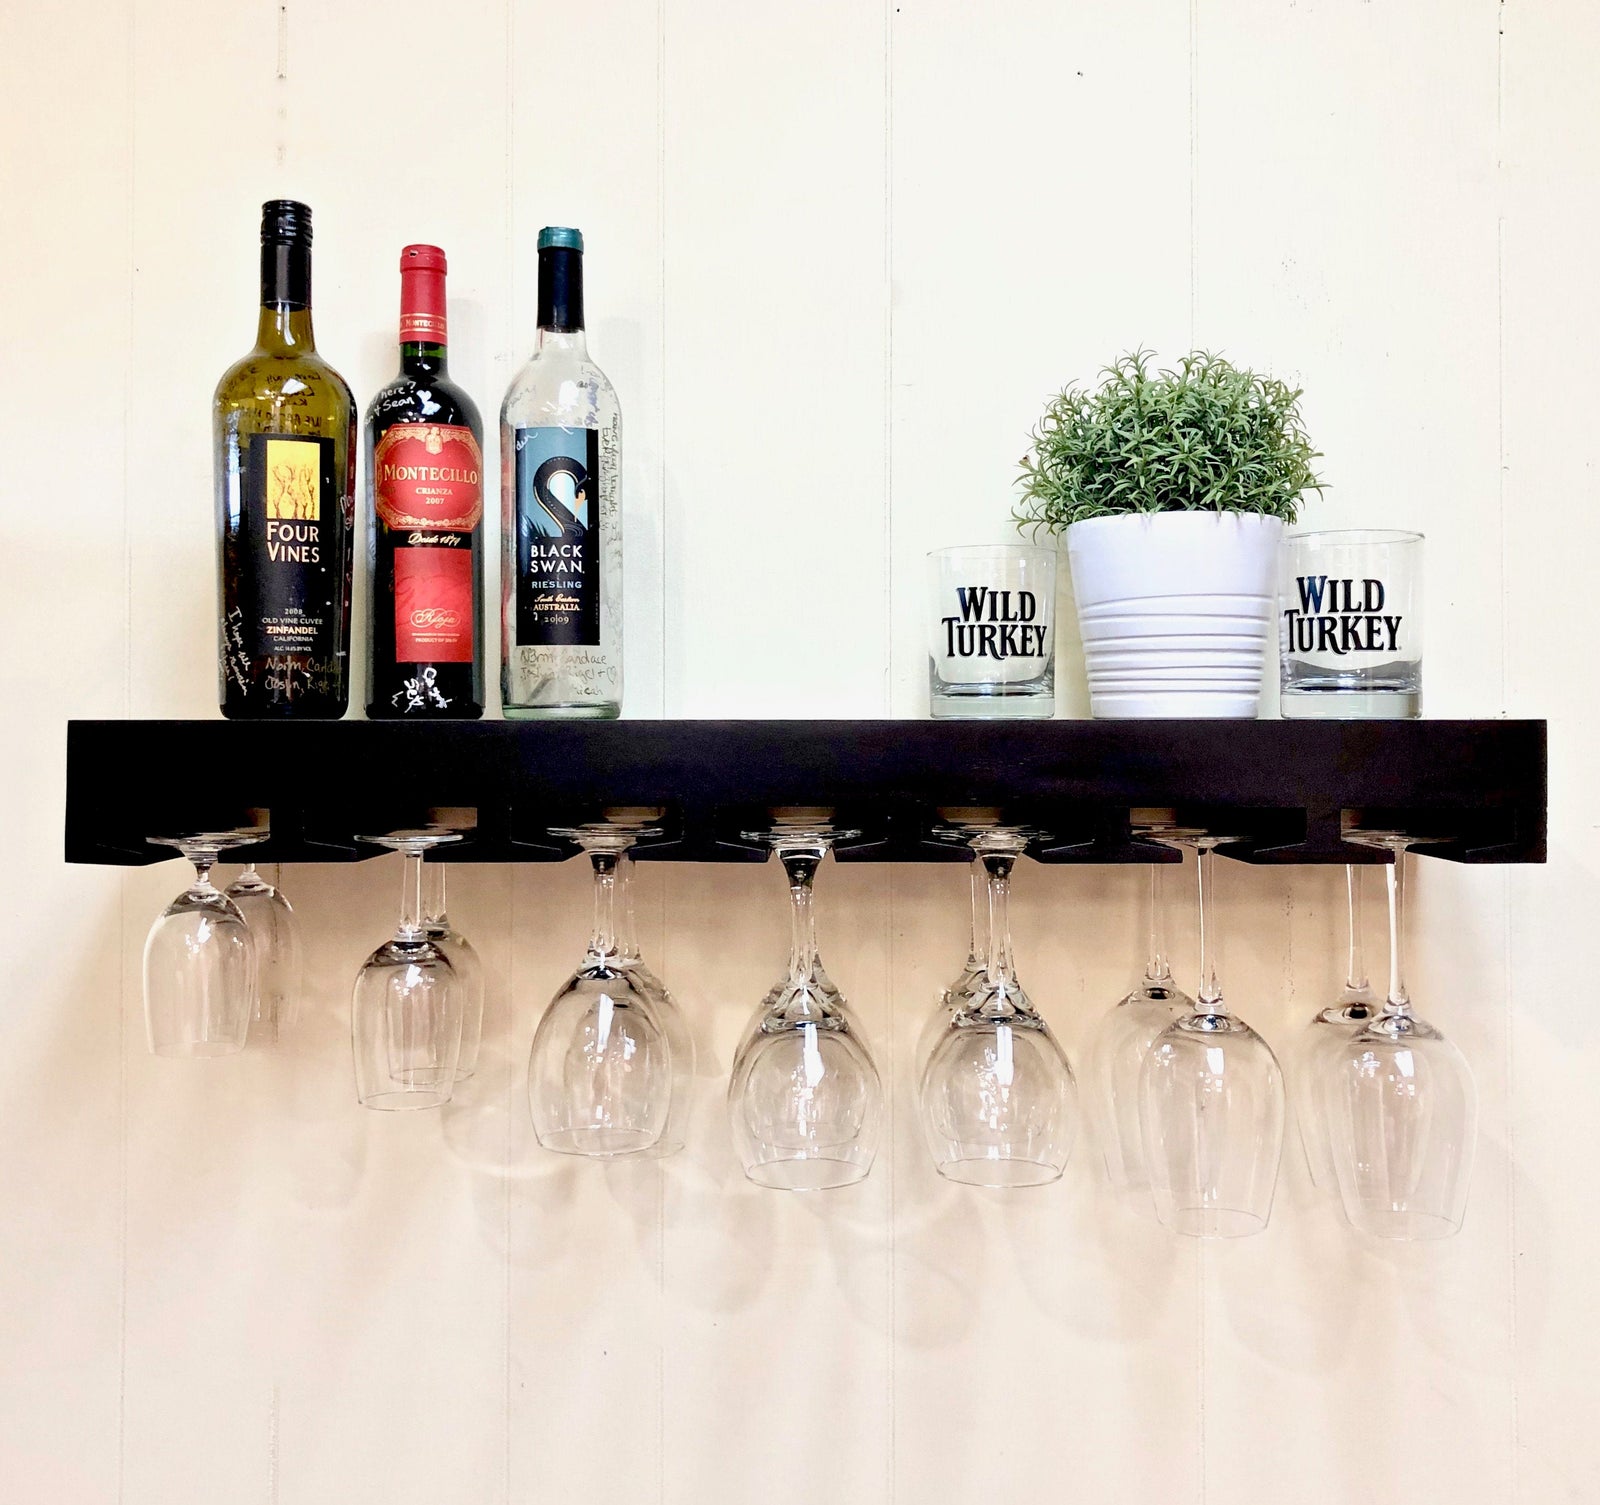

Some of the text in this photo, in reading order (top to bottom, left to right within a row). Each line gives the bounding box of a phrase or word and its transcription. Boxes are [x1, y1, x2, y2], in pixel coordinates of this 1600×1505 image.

[382, 397, 415, 412] Sean
[384, 463, 478, 485] MONTECILLO
[415, 487, 453, 496] CRIANZA
[425, 497, 445, 505] 2007
[267, 521, 320, 543] FOUR
[407, 532, 438, 545] Desde
[267, 541, 321, 563] VINES
[531, 544, 583, 558] BLACK
[530, 560, 583, 573] SWAN
[531, 581, 582, 589] RIESLING
[1296, 575, 1385, 614] WILD
[533, 603, 580, 611] AUSTRALIA
[956, 586, 1036, 622] WILD
[266, 626, 319, 635] ZINFANDEL
[1284, 608, 1403, 655] TURKEY
[941, 616, 1048, 661] TURKEY
